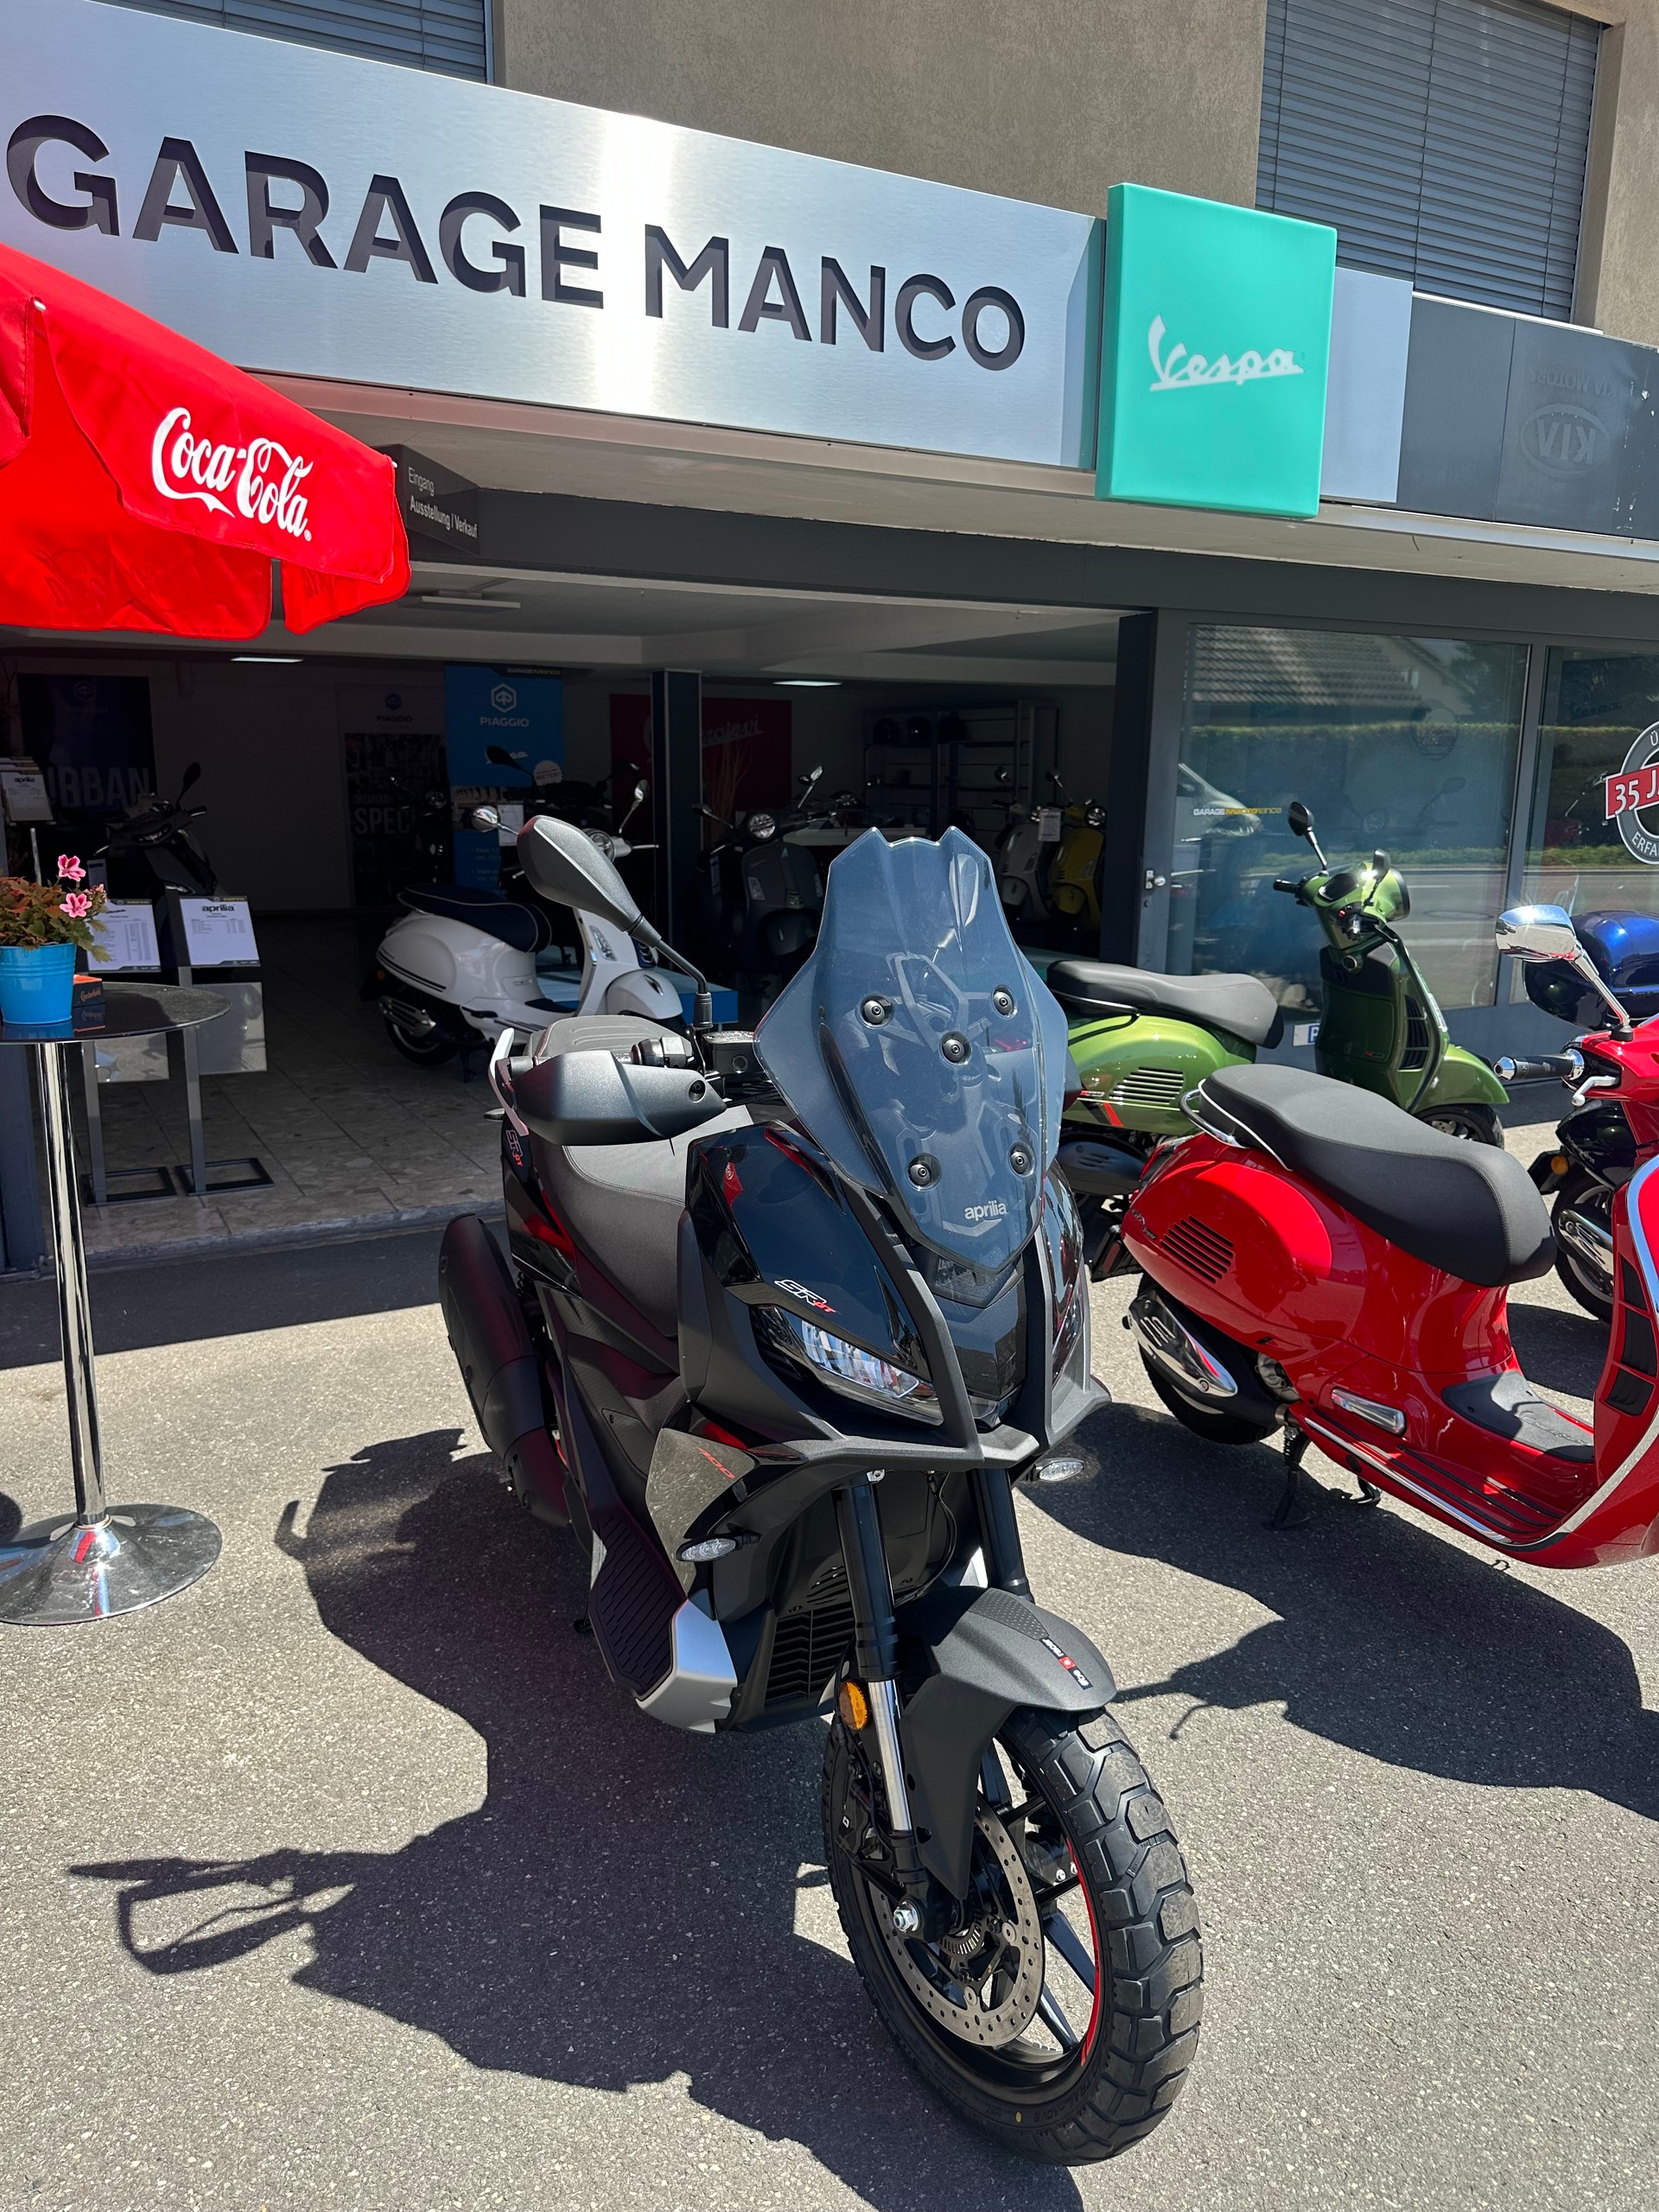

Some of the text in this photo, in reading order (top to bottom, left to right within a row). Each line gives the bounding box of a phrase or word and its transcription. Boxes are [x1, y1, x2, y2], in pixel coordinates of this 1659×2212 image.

[6, 114, 1026, 372] GARAGE MANCO
[1147, 314, 1305, 391] Vespa
[152, 407, 314, 538] Coca-Cola
[408, 467, 435, 497] Eingang
[410, 495, 450, 531] Ausstellung
[454, 514, 477, 538] Verkauf
[376, 715, 413, 723] PIAGGIO
[480, 716, 530, 728] PIAGGIO
[1614, 769, 1659, 816] 35 J
[1631, 831, 1659, 857] ERFA
[202, 904, 235, 912] aprilia
[505, 1129, 524, 1158] SR
[964, 1200, 1007, 1221] aprilia
[774, 1279, 827, 1306] SR
